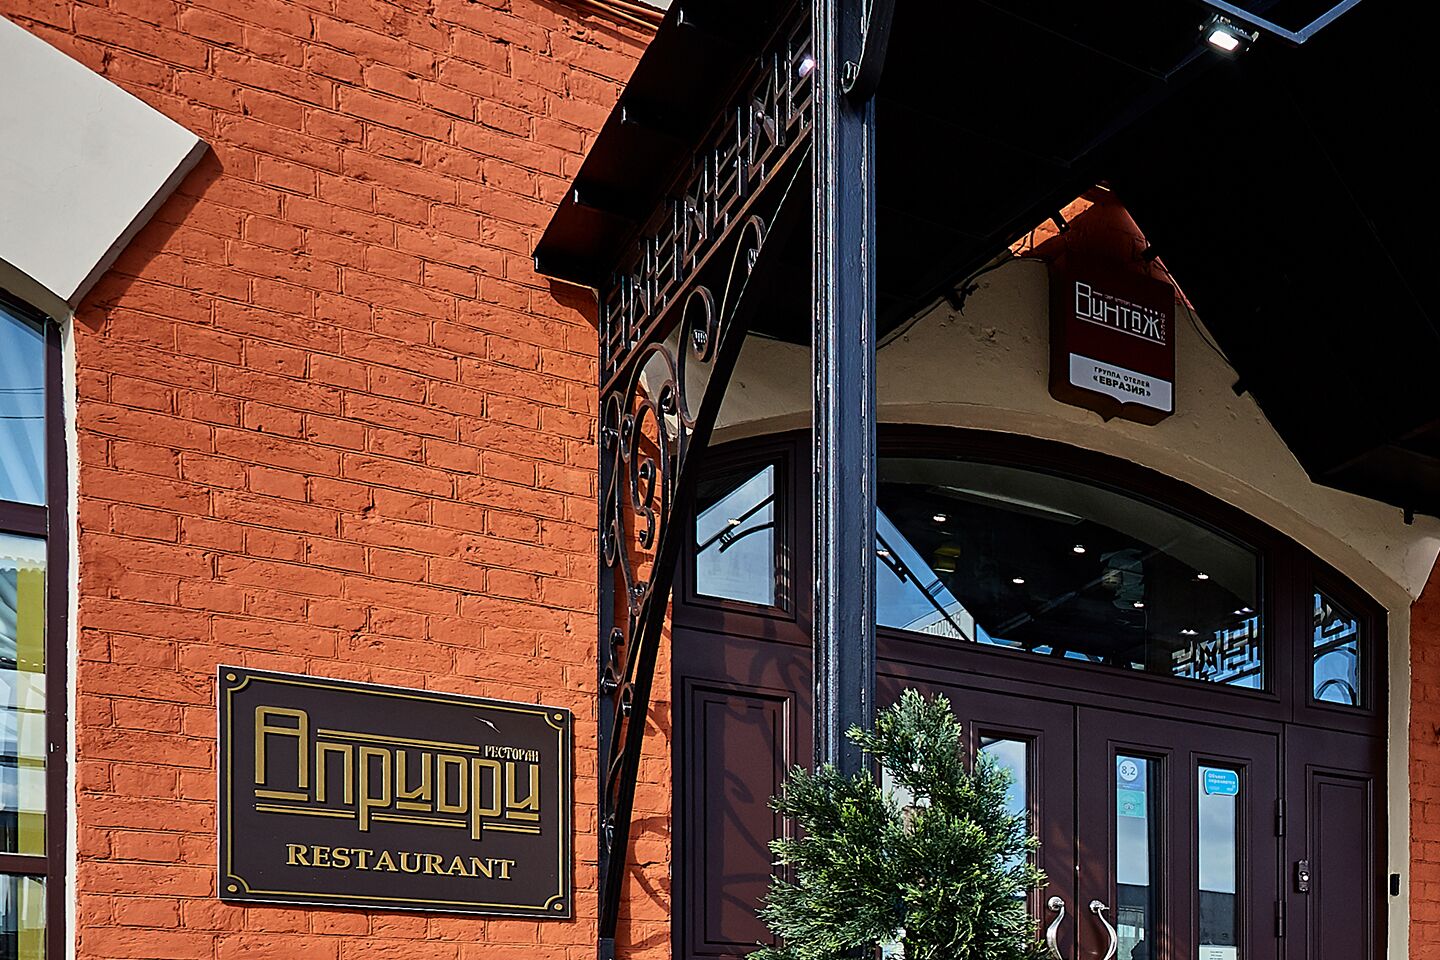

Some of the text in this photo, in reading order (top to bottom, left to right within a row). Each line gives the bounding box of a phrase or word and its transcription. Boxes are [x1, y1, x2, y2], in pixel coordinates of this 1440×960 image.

[1093, 375, 1151, 397] «ЕВРАЗИЯ»
[1094, 366, 1150, 388] ГРУППА ОТЕЛЕЙ
[484, 745, 539, 762] РЕСТОРАН
[1121, 765, 1136, 776] 8,2
[286, 842, 515, 880] RESTAURANT
